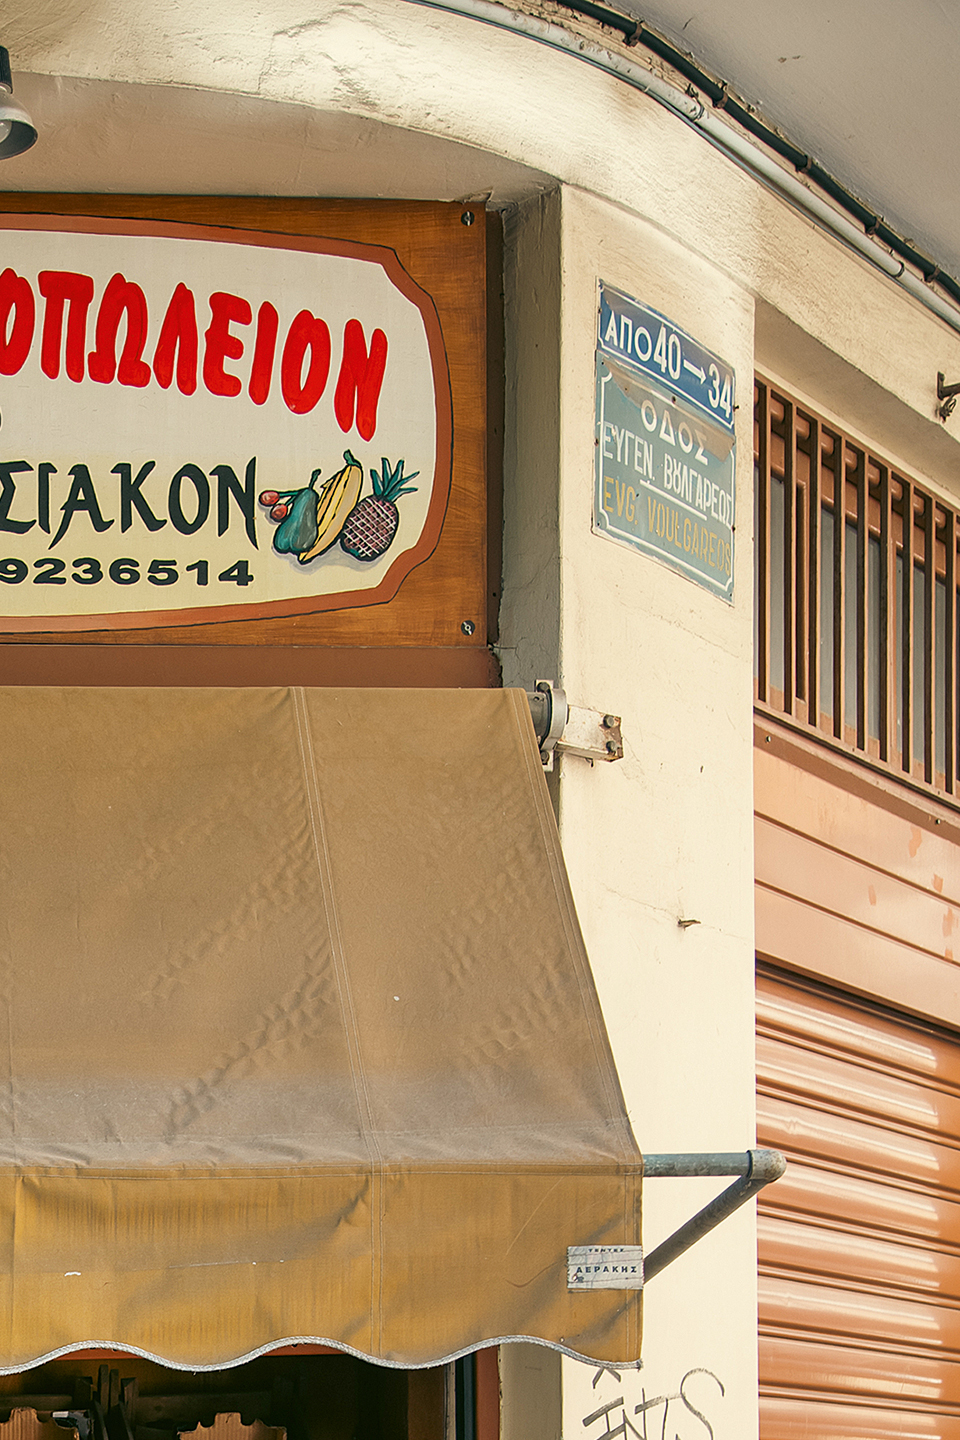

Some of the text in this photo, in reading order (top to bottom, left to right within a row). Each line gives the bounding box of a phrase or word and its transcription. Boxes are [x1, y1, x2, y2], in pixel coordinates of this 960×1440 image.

[641, 400, 708, 465] ΟΔΟΣ
[604, 475, 731, 576] EVG. VOULGAREOS
